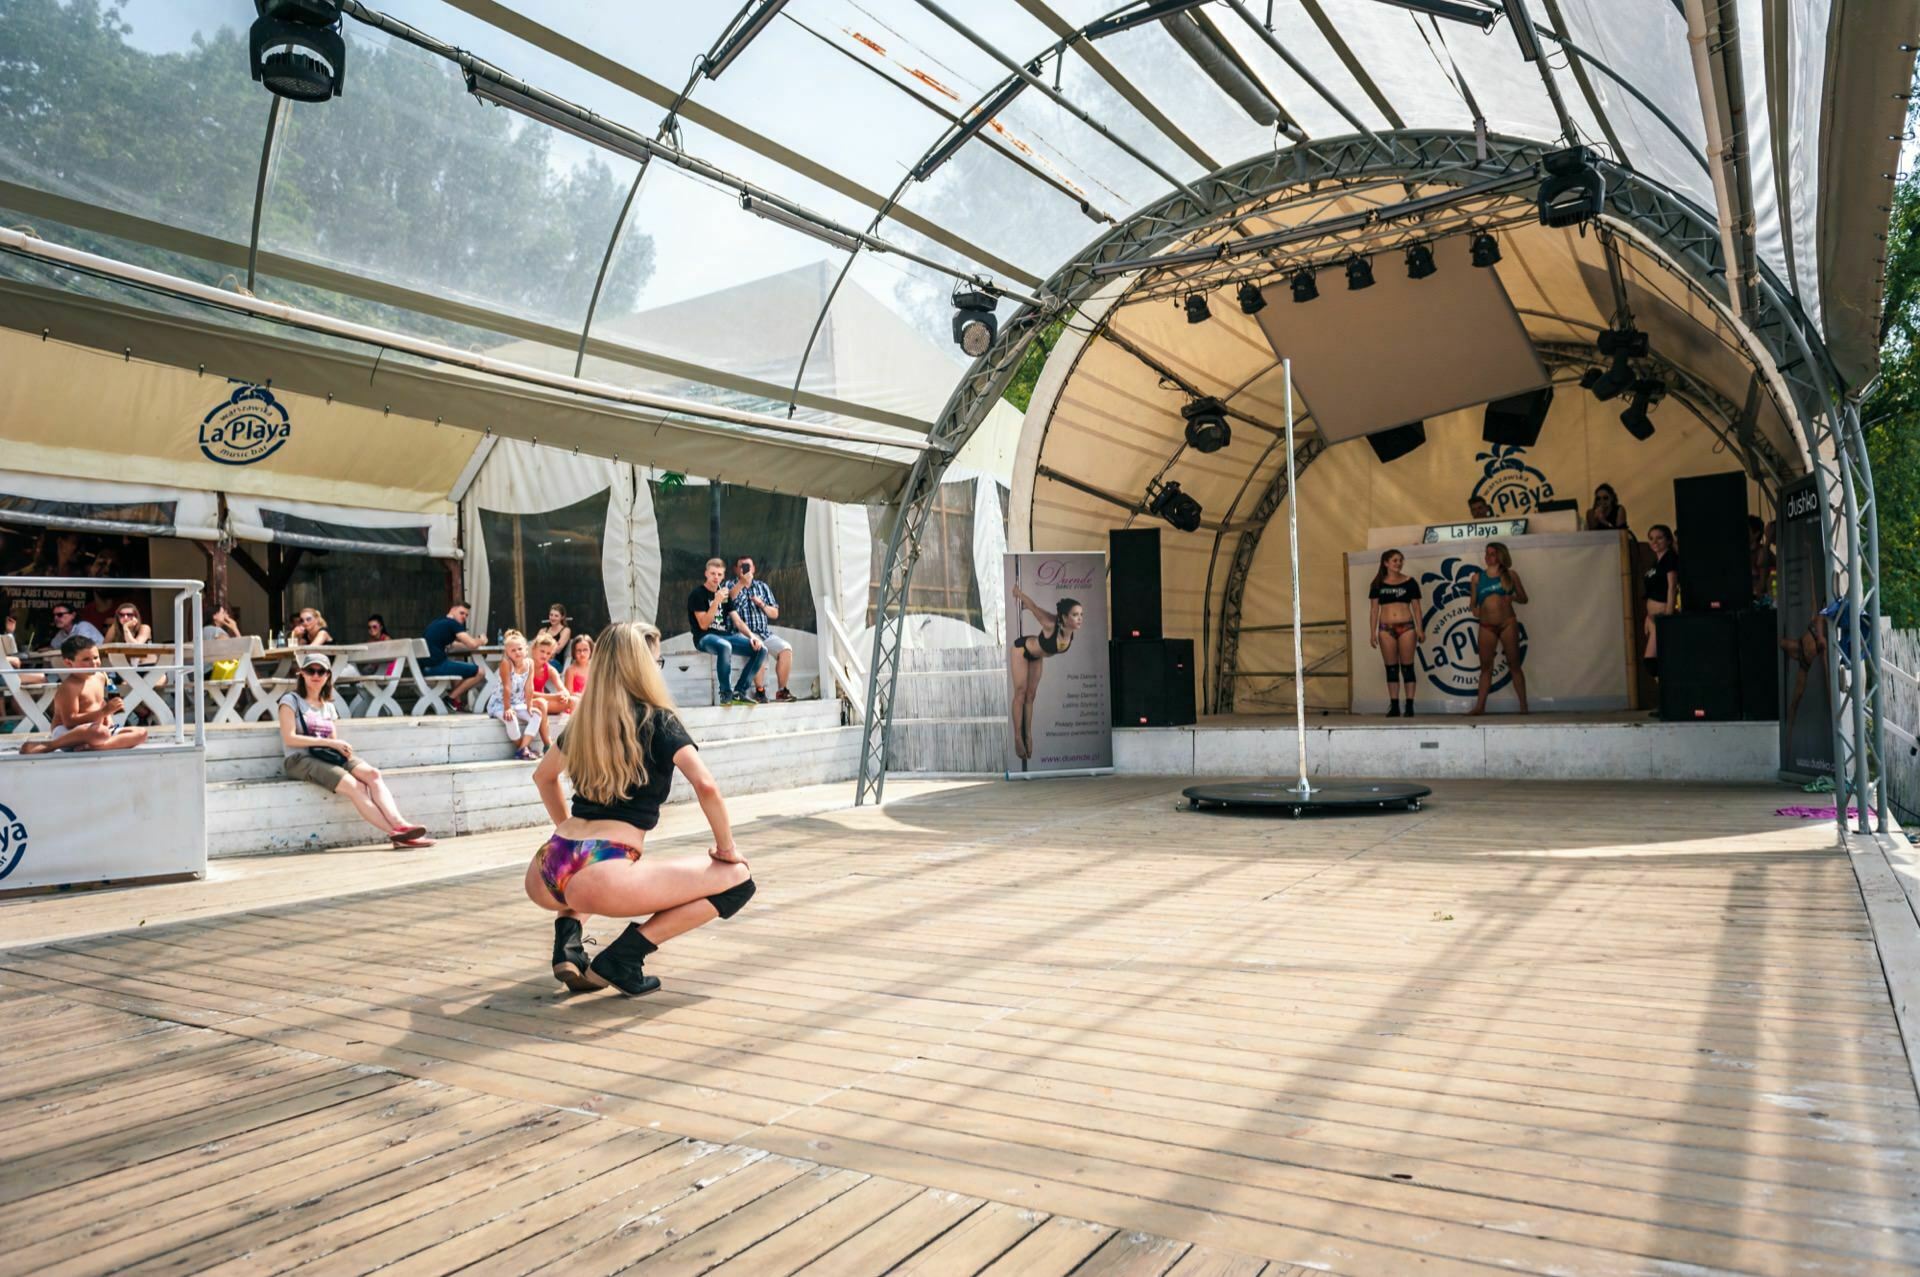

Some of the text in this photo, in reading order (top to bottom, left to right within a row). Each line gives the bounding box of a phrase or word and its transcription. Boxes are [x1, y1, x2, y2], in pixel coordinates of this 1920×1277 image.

[198, 420, 291, 443] La Playa
[220, 445, 268, 458] music bar
[1497, 483, 1554, 513] Playa
[1787, 489, 1817, 518] dushko
[1451, 525, 1463, 538] La
[1467, 523, 1498, 538] Playa
[43, 589, 64, 598] KNOW
[1433, 606, 1473, 634] warszaw
[1416, 646, 1449, 672] La
[1452, 674, 1480, 685] mus
